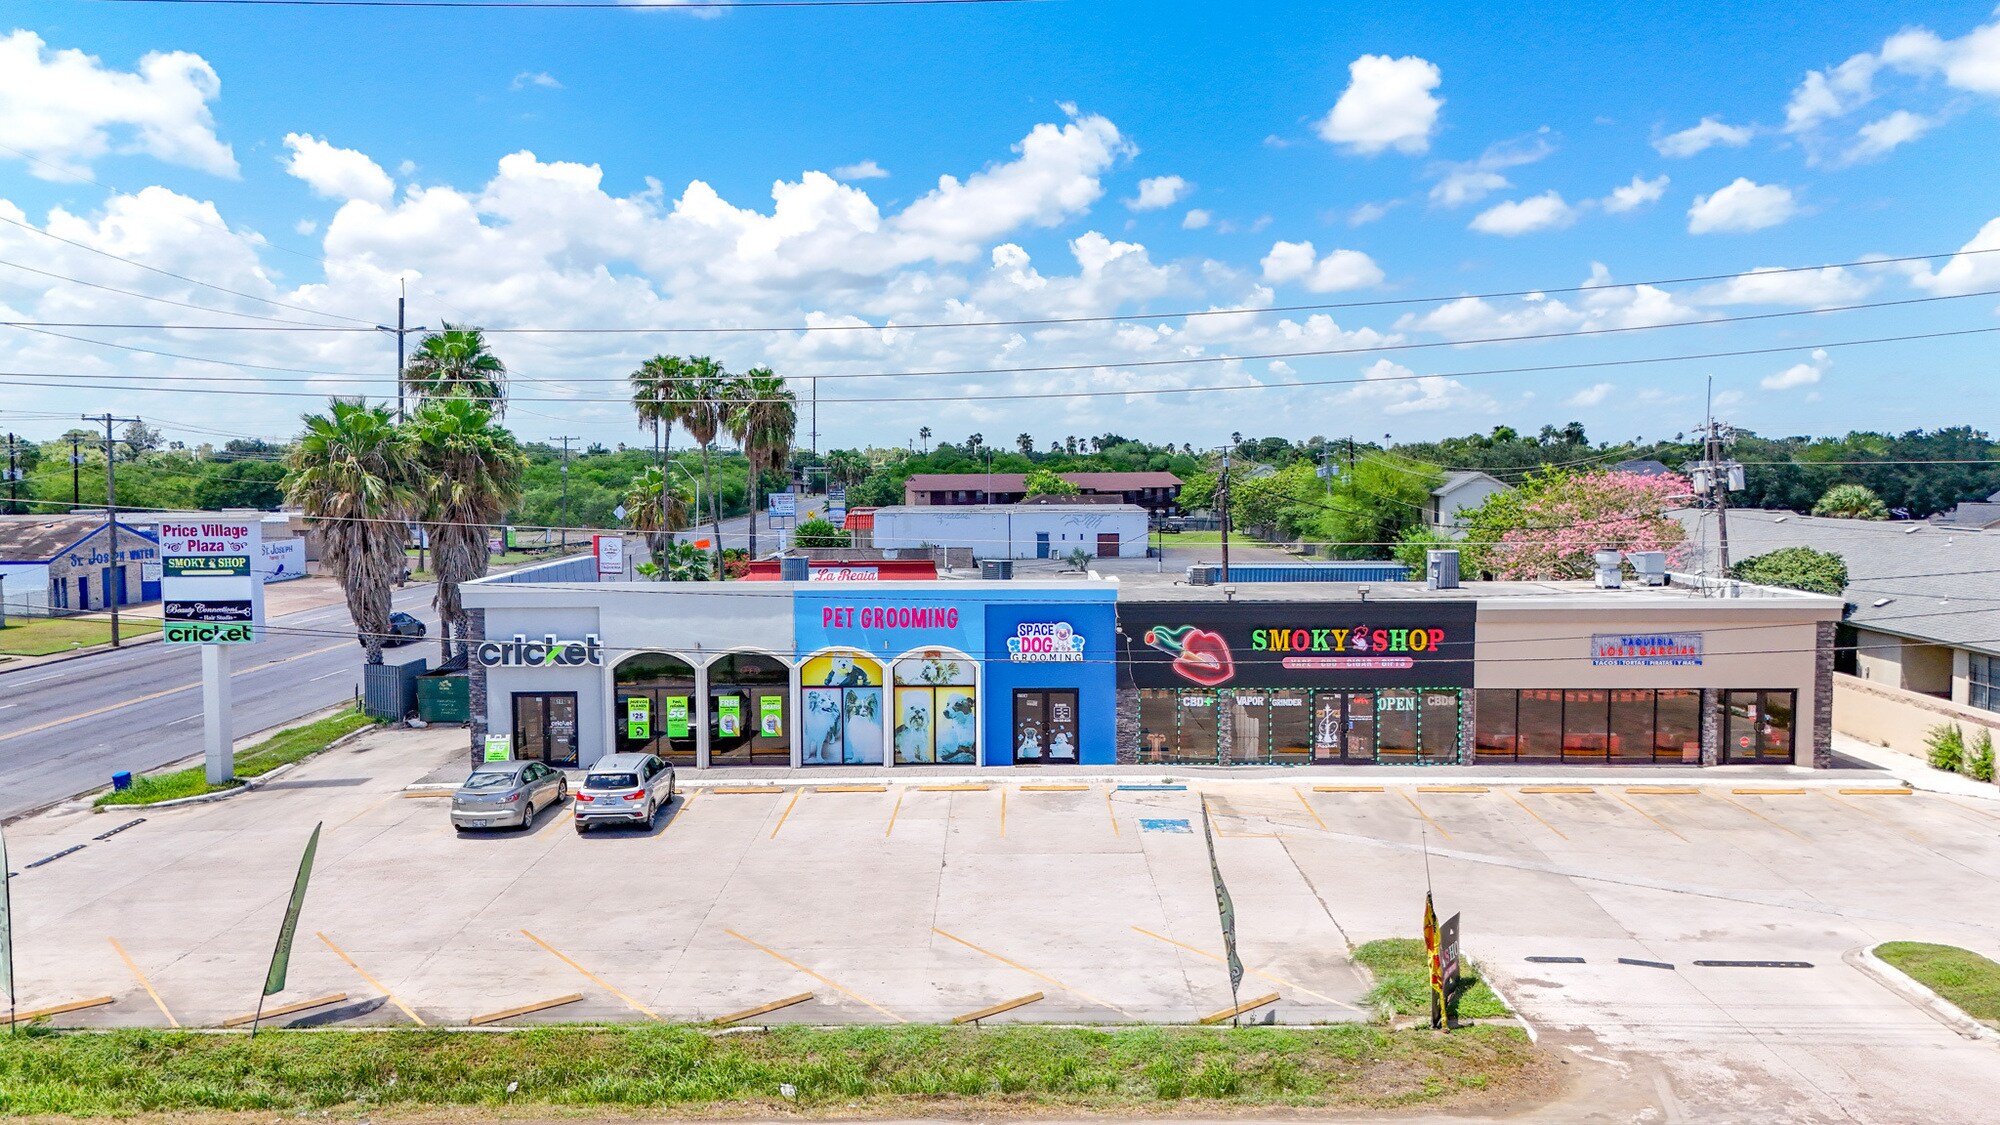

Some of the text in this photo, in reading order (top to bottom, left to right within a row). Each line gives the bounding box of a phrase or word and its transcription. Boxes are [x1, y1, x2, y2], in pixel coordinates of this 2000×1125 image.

[162, 524, 248, 539] Price Village
[187, 540, 225, 552] Plaza
[88, 547, 125, 565] JOSPH
[129, 548, 155, 560] WATER
[168, 557, 246, 568] SMOKY SHOP
[814, 568, 835, 581] La
[165, 603, 239, 617] Beauty Connections
[822, 607, 959, 629] PET GROOMING
[168, 625, 251, 642] cricket
[1019, 624, 1054, 636] SPACE
[1021, 637, 1053, 653] DOG
[1252, 628, 1445, 651] SMOKY SHOP
[1622, 638, 1674, 646] TAQUERIA
[478, 636, 602, 667] cricket
[1012, 653, 1082, 662] GROOMING
[1600, 647, 1623, 657] LOS
[1639, 646, 1696, 657] GARCIAS
[1346, 659, 1373, 667] CIGAR
[1381, 658, 1406, 667] GIFTS
[1235, 695, 1264, 706] VAPOR
[1271, 698, 1303, 707] GRINDER
[1378, 696, 1415, 711] OPEN
